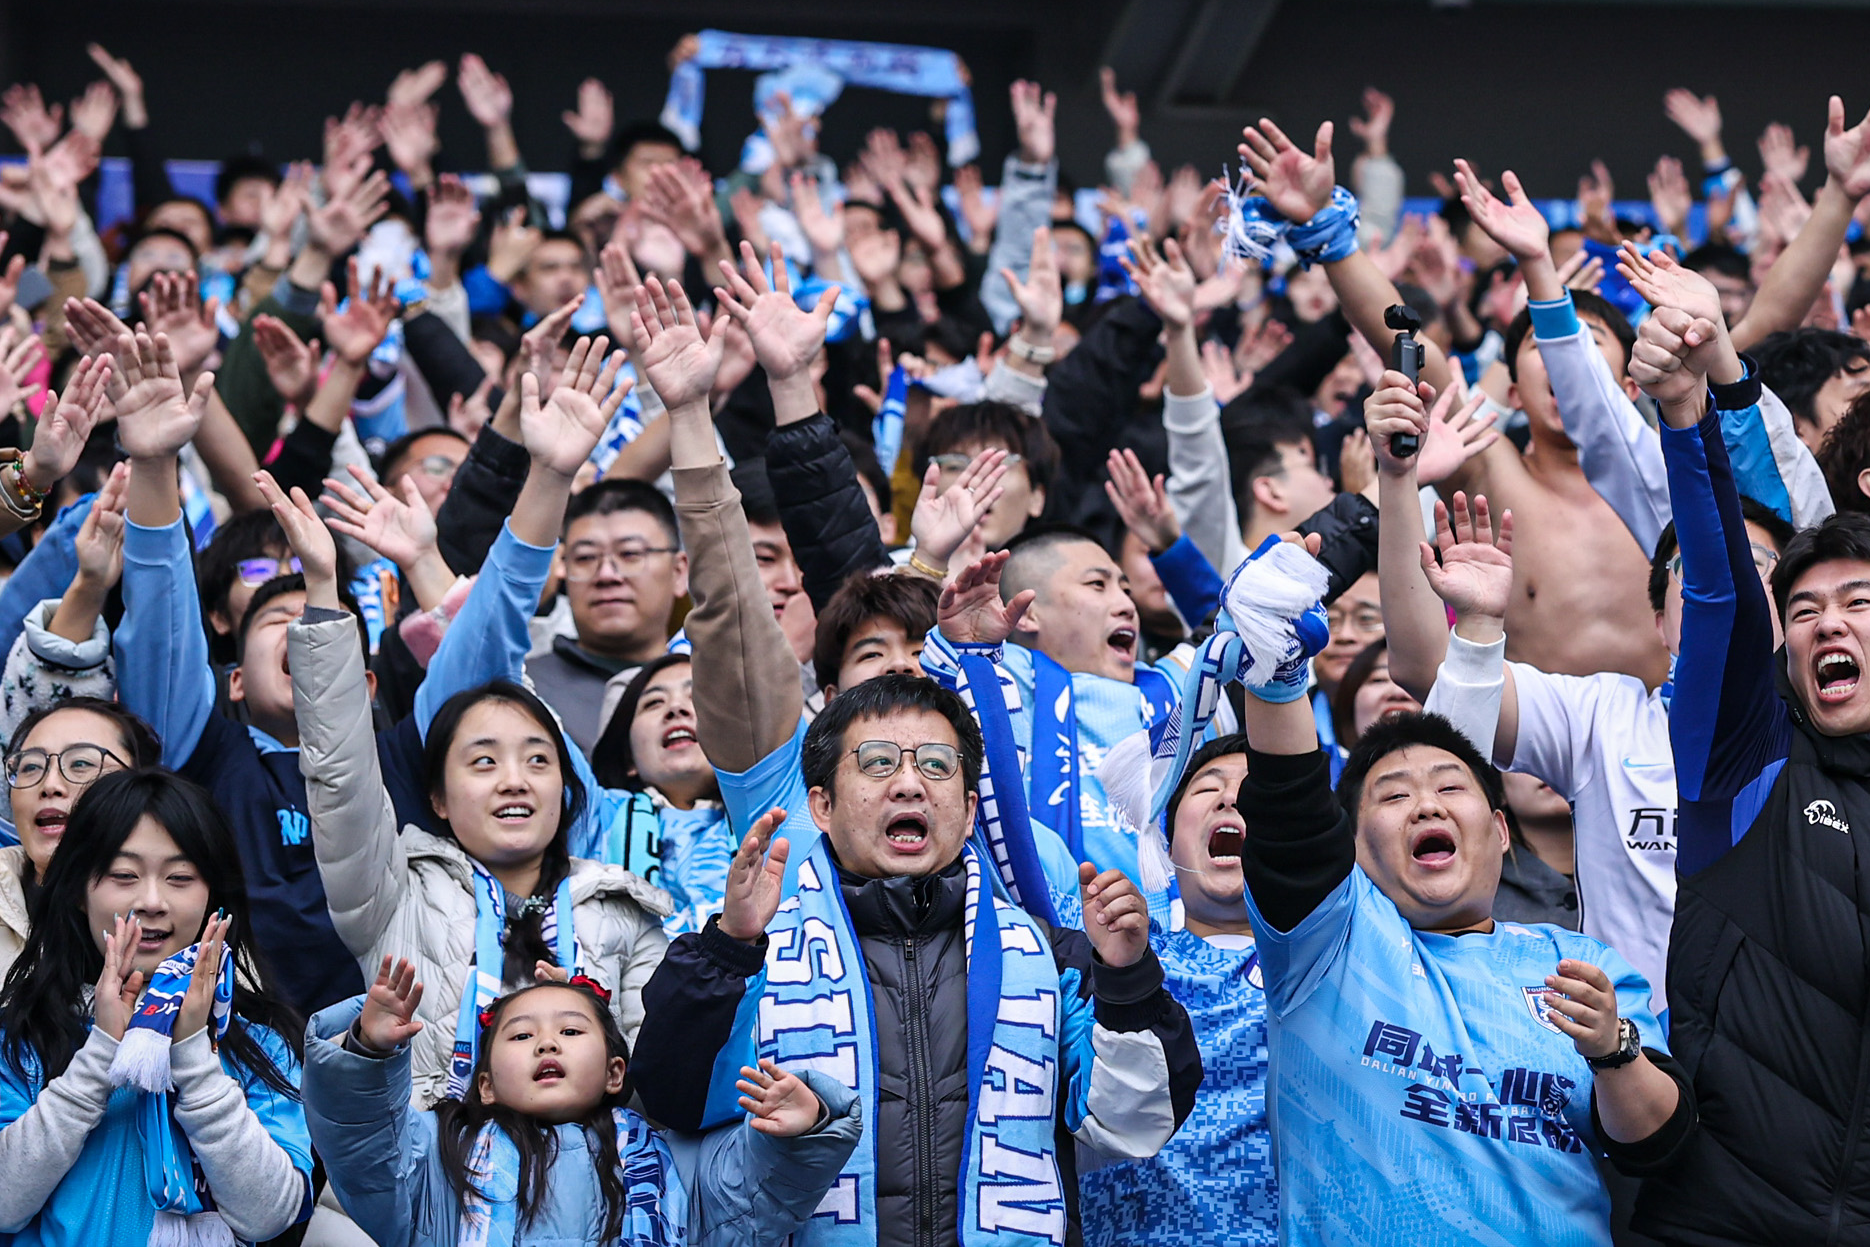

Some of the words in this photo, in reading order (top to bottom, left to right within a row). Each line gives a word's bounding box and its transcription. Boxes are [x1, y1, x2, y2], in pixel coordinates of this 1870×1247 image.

[1628, 807, 1678, 837] 万
[1626, 840, 1678, 851] WAN
[1360, 1056, 1417, 1081] DALIAN
